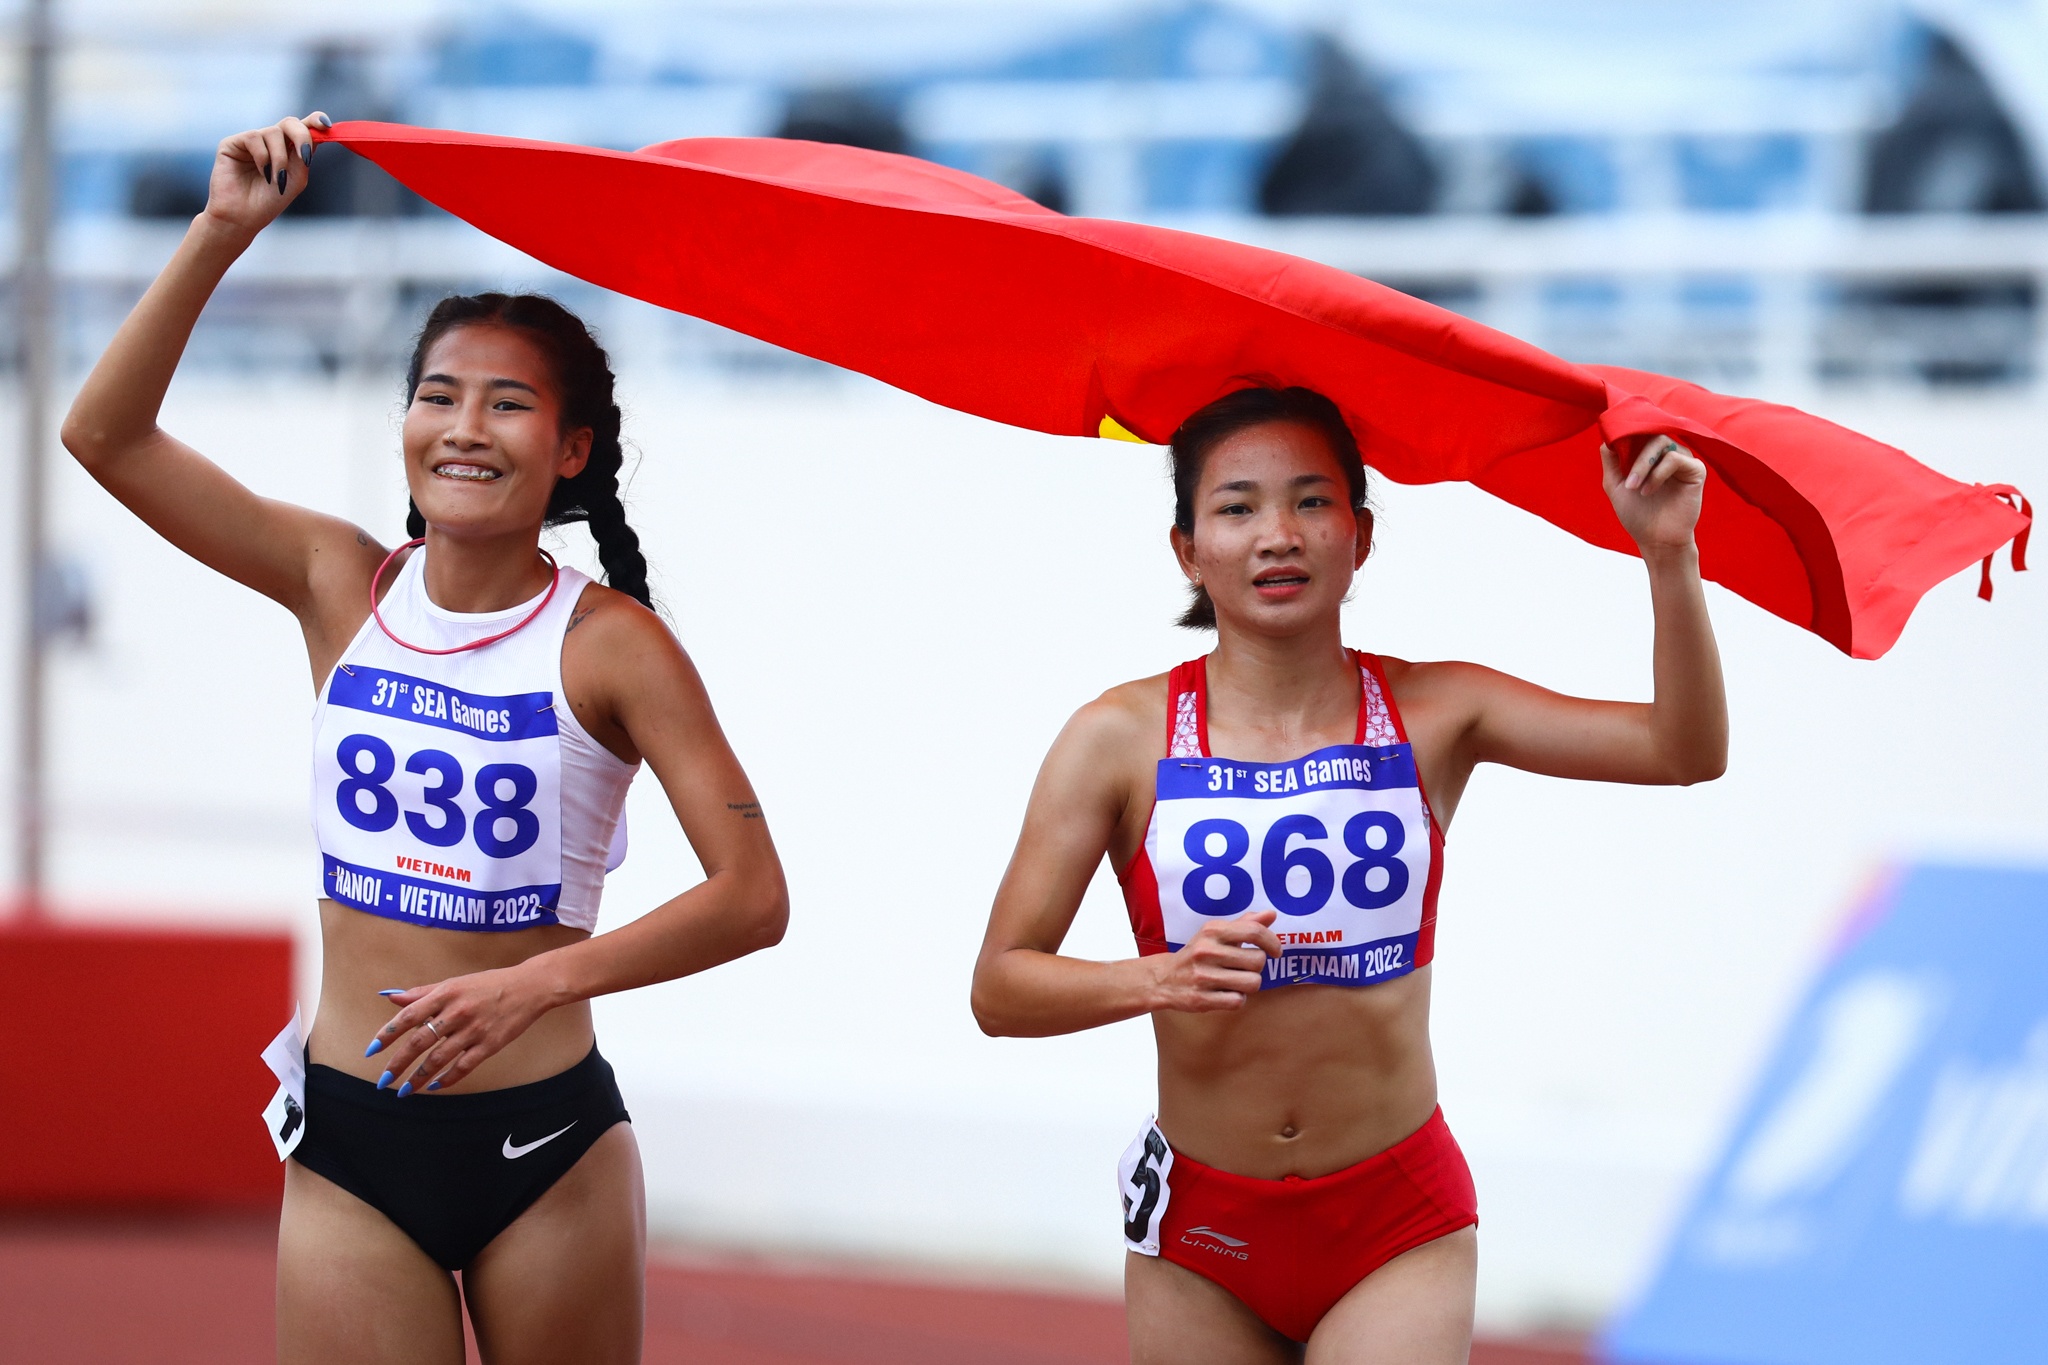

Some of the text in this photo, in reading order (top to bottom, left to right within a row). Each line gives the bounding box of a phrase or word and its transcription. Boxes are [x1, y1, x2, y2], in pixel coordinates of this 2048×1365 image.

[411, 686, 447, 720] SEA
[451, 695, 511, 733] Games
[1254, 767, 1299, 793] SEA
[1303, 757, 1372, 787] Games
[336, 734, 540, 859] 838
[396, 855, 471, 883] VIETNAM
[1182, 810, 1410, 917] 868
[335, 865, 381, 906] HANOI
[400, 884, 486, 925] VIETNAM
[492, 893, 541, 925] 2022
[1276, 929, 1343, 945] ETNAM
[1266, 943, 1404, 981] VIETNAM 2022
[1180, 1235, 1249, 1261] LI-NING
